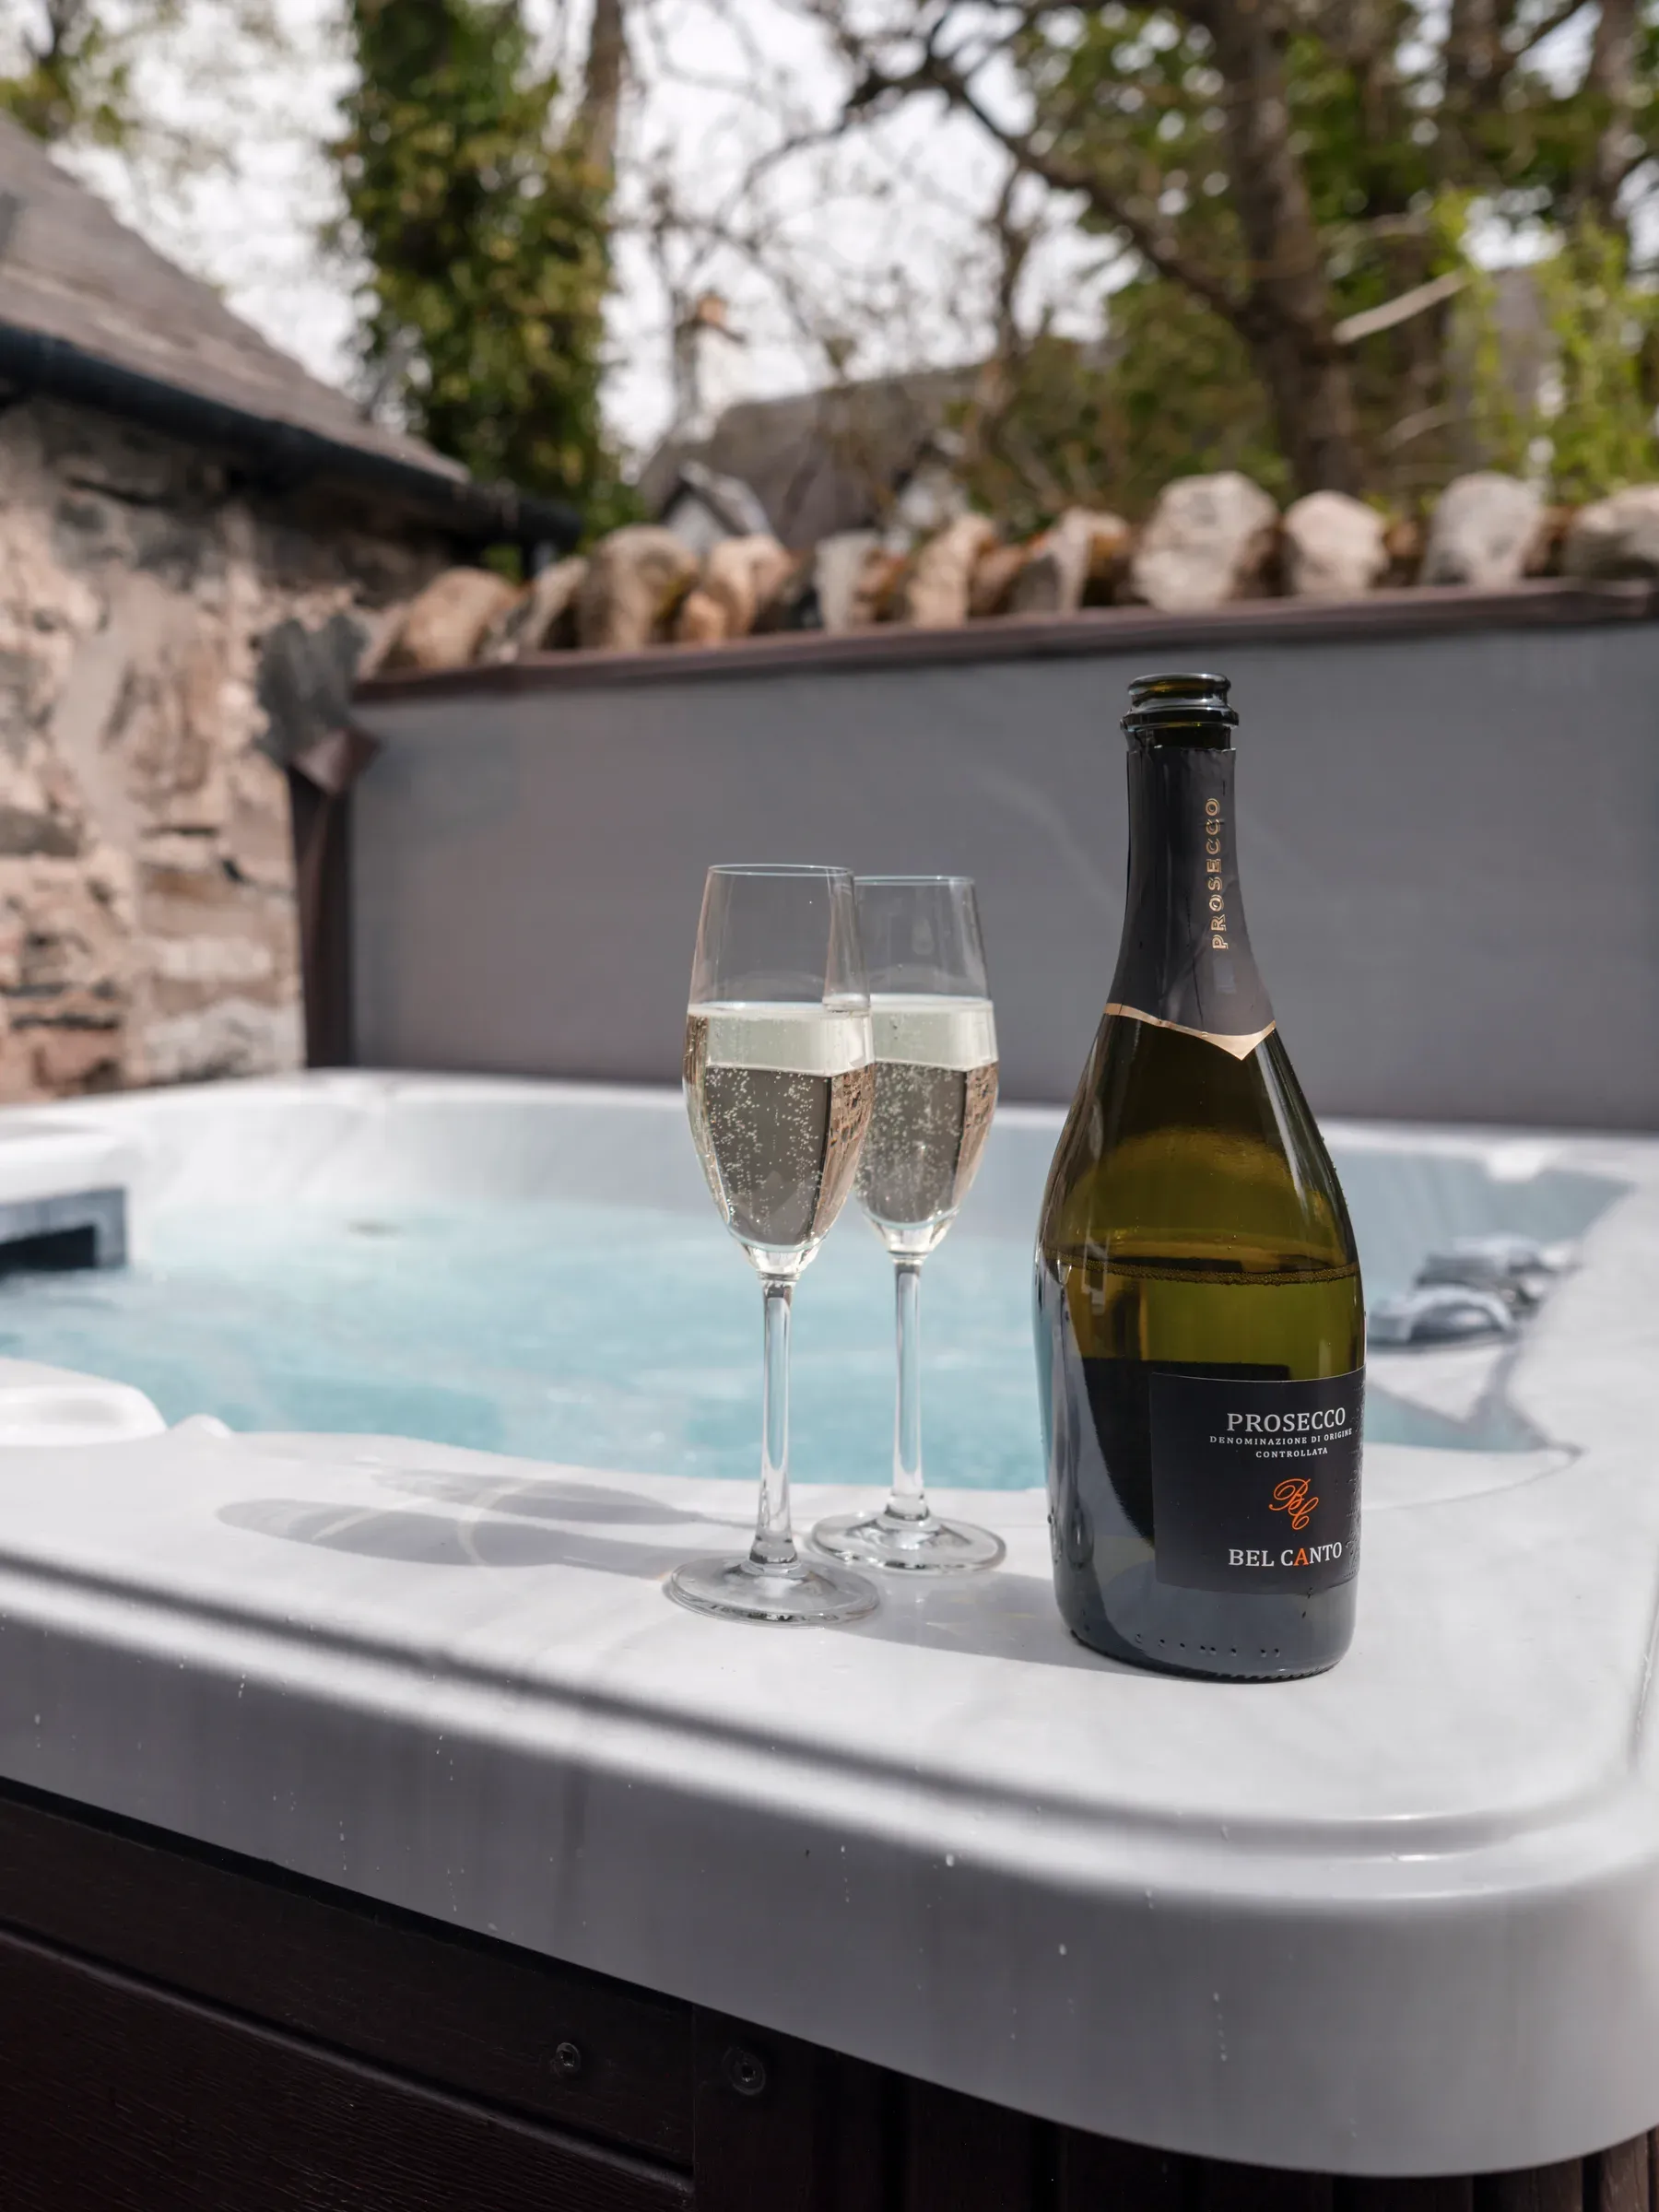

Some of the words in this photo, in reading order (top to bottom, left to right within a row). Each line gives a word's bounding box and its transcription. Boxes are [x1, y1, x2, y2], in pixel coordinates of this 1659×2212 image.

[1205, 797, 1229, 950] PROSECCO
[1226, 1406, 1347, 1433] PROSECCO
[1209, 1435, 1308, 1446] DENOMINAZIONE
[1311, 1435, 1321, 1443] DI
[1324, 1428, 1353, 1441] ORIGINE
[1255, 1447, 1329, 1458] CONTROLLATA
[1228, 1548, 1275, 1567] BEL
[1280, 1541, 1343, 1568] CANTO
